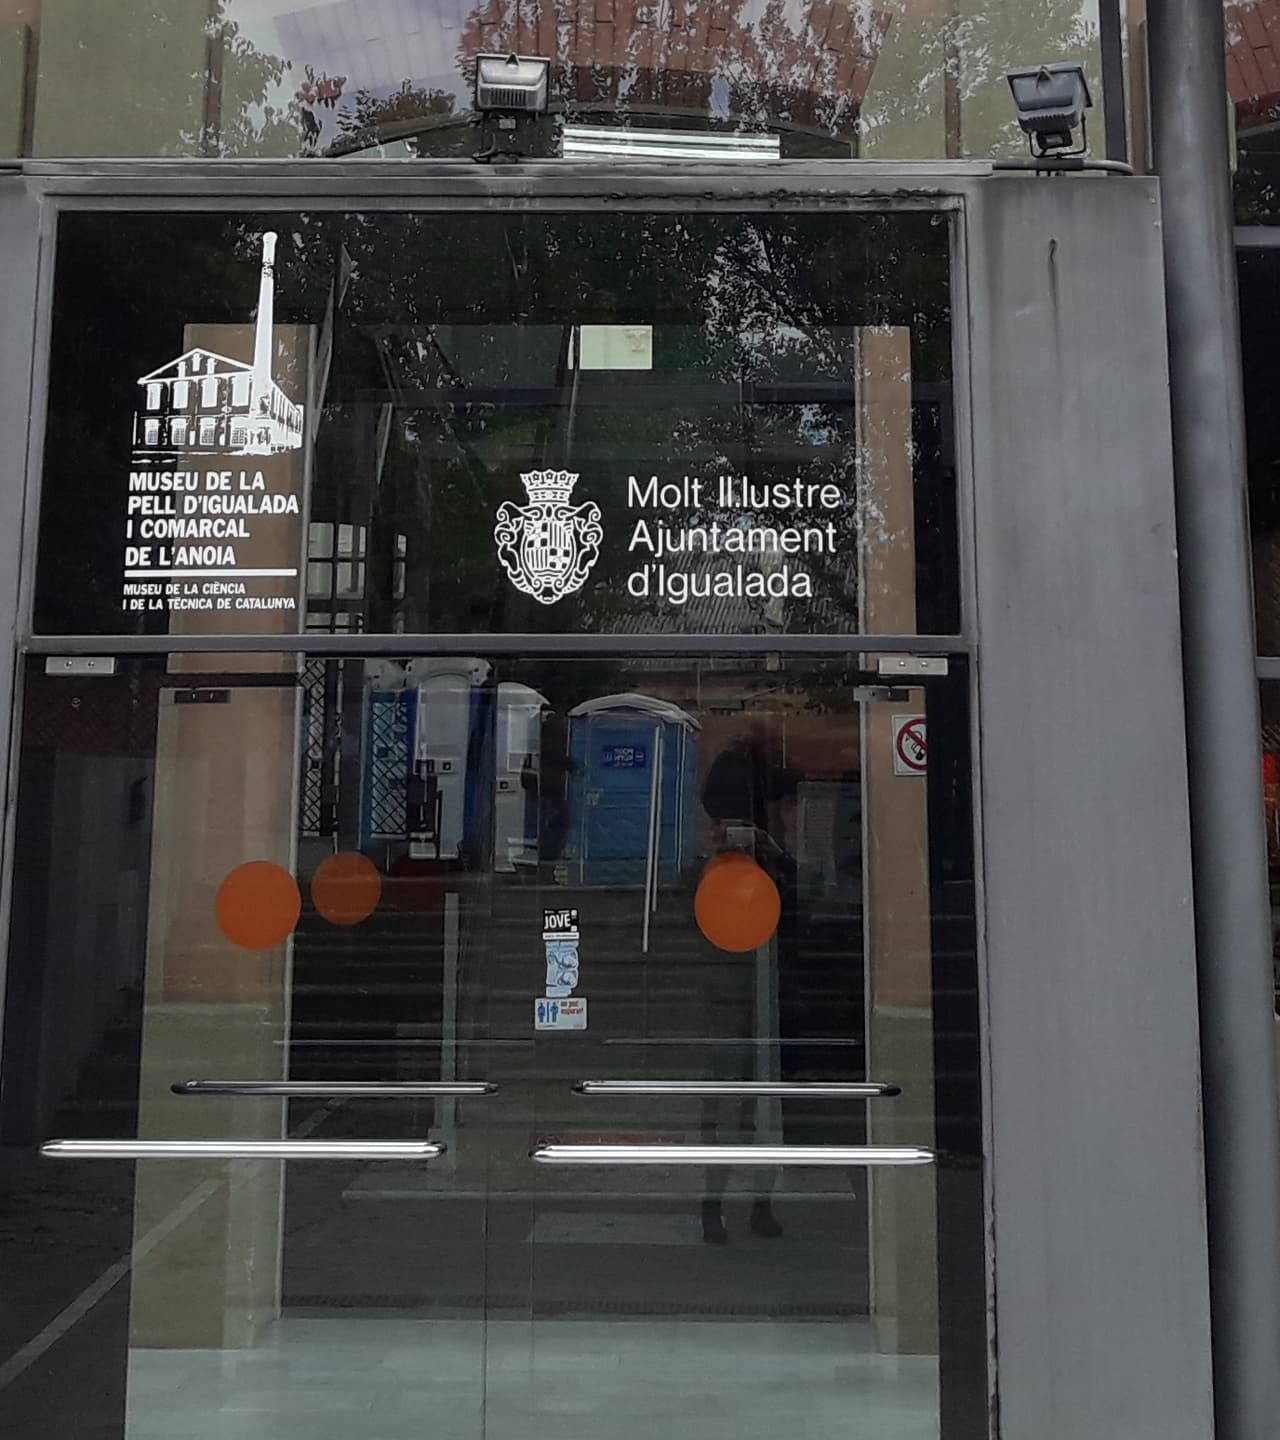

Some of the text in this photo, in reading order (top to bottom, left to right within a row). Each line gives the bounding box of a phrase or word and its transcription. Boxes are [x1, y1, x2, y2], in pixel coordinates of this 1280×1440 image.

[129, 471, 265, 491] MUSEU DE LA
[627, 476, 702, 508] Molt
[127, 495, 299, 515] PELL D'IGUALADA
[126, 518, 250, 539] I COMARCAL
[628, 519, 837, 558] Ajuntament
[125, 546, 236, 566] DE L'ANOIA
[123, 581, 246, 595] MUSEU DE LA CIÈNCIA
[627, 564, 813, 605] d'Igualada
[122, 598, 127, 610] I
[130, 598, 145, 610] DE
[148, 598, 163, 610] LA
[217, 598, 231, 609] DE
[235, 597, 296, 609] CATALUNYA
[544, 913, 571, 930] JOVE
